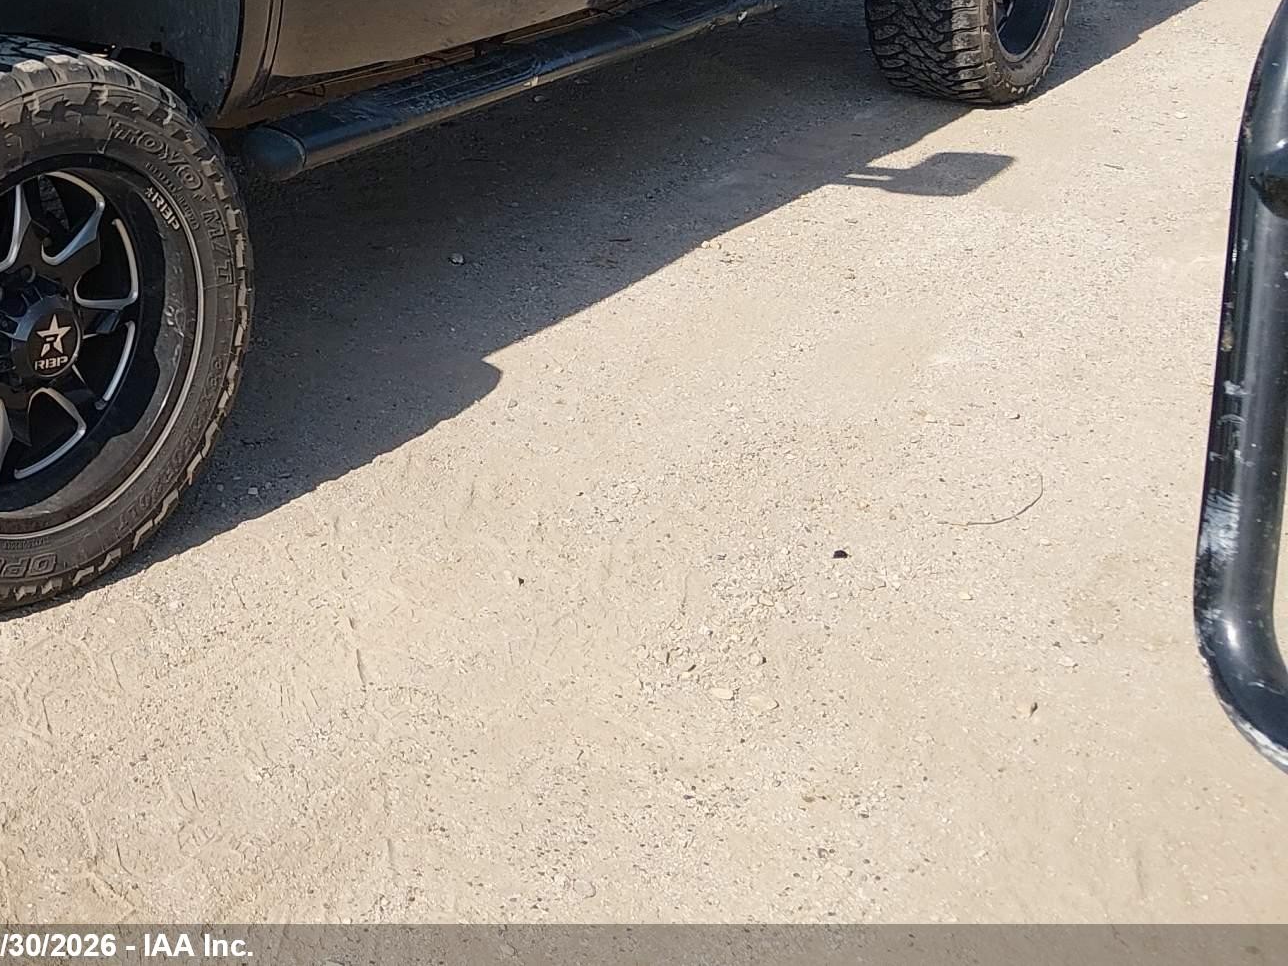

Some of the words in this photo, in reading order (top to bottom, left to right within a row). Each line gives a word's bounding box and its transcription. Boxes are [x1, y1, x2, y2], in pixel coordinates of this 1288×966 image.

[109, 119, 204, 191] TOYO
[150, 192, 181, 231] RBP
[202, 209, 234, 284] M/T
[34, 356, 69, 371] RBP
